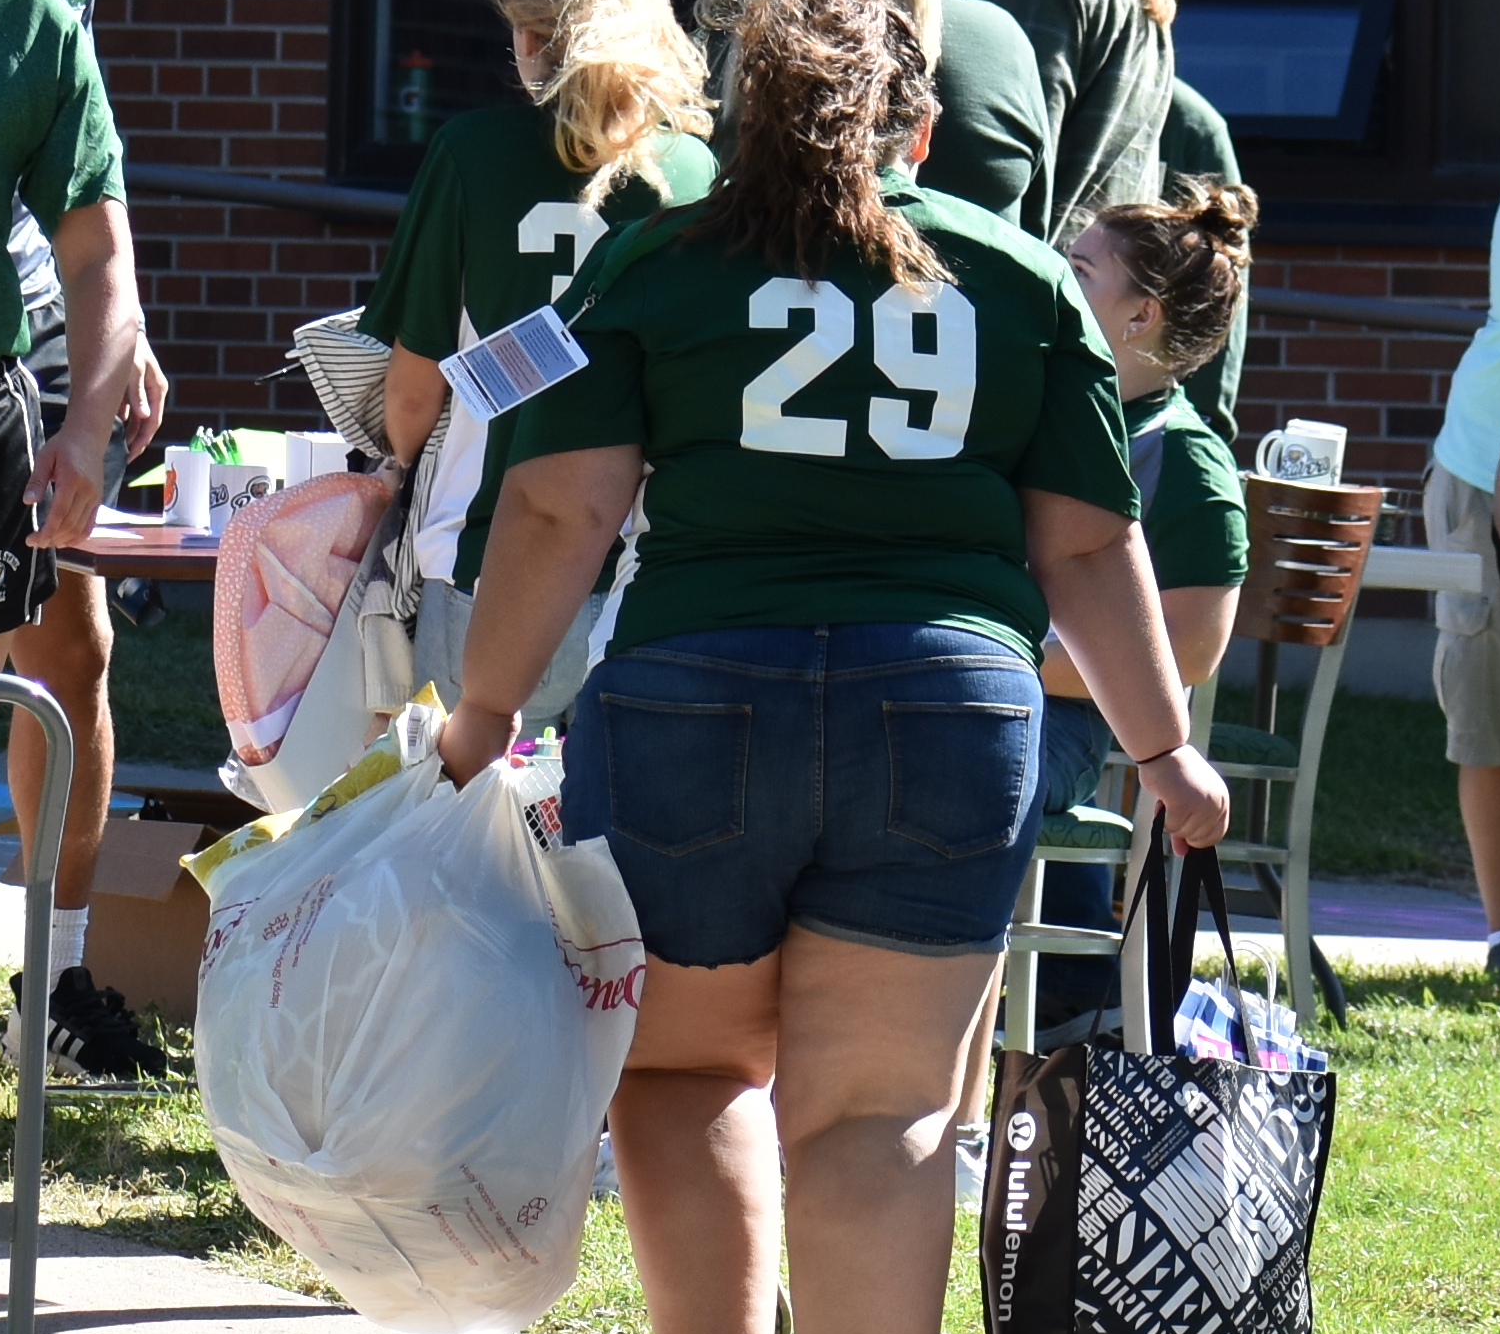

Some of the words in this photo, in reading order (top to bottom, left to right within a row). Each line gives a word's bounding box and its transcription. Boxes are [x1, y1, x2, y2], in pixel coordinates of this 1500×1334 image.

[739, 277, 977, 460] 29
[3, 550, 20, 571] STATE
[1173, 1081, 1221, 1127] SET
[1085, 1111, 1146, 1183] RSELF
[1095, 1186, 1134, 1223] YOU
[1244, 1174, 1294, 1245] GOALS
[998, 1161, 1031, 1321] lululemon
[1259, 1240, 1301, 1295] strategy
[1271, 1286, 1280, 1299] a
[1280, 1265, 1298, 1292] not
